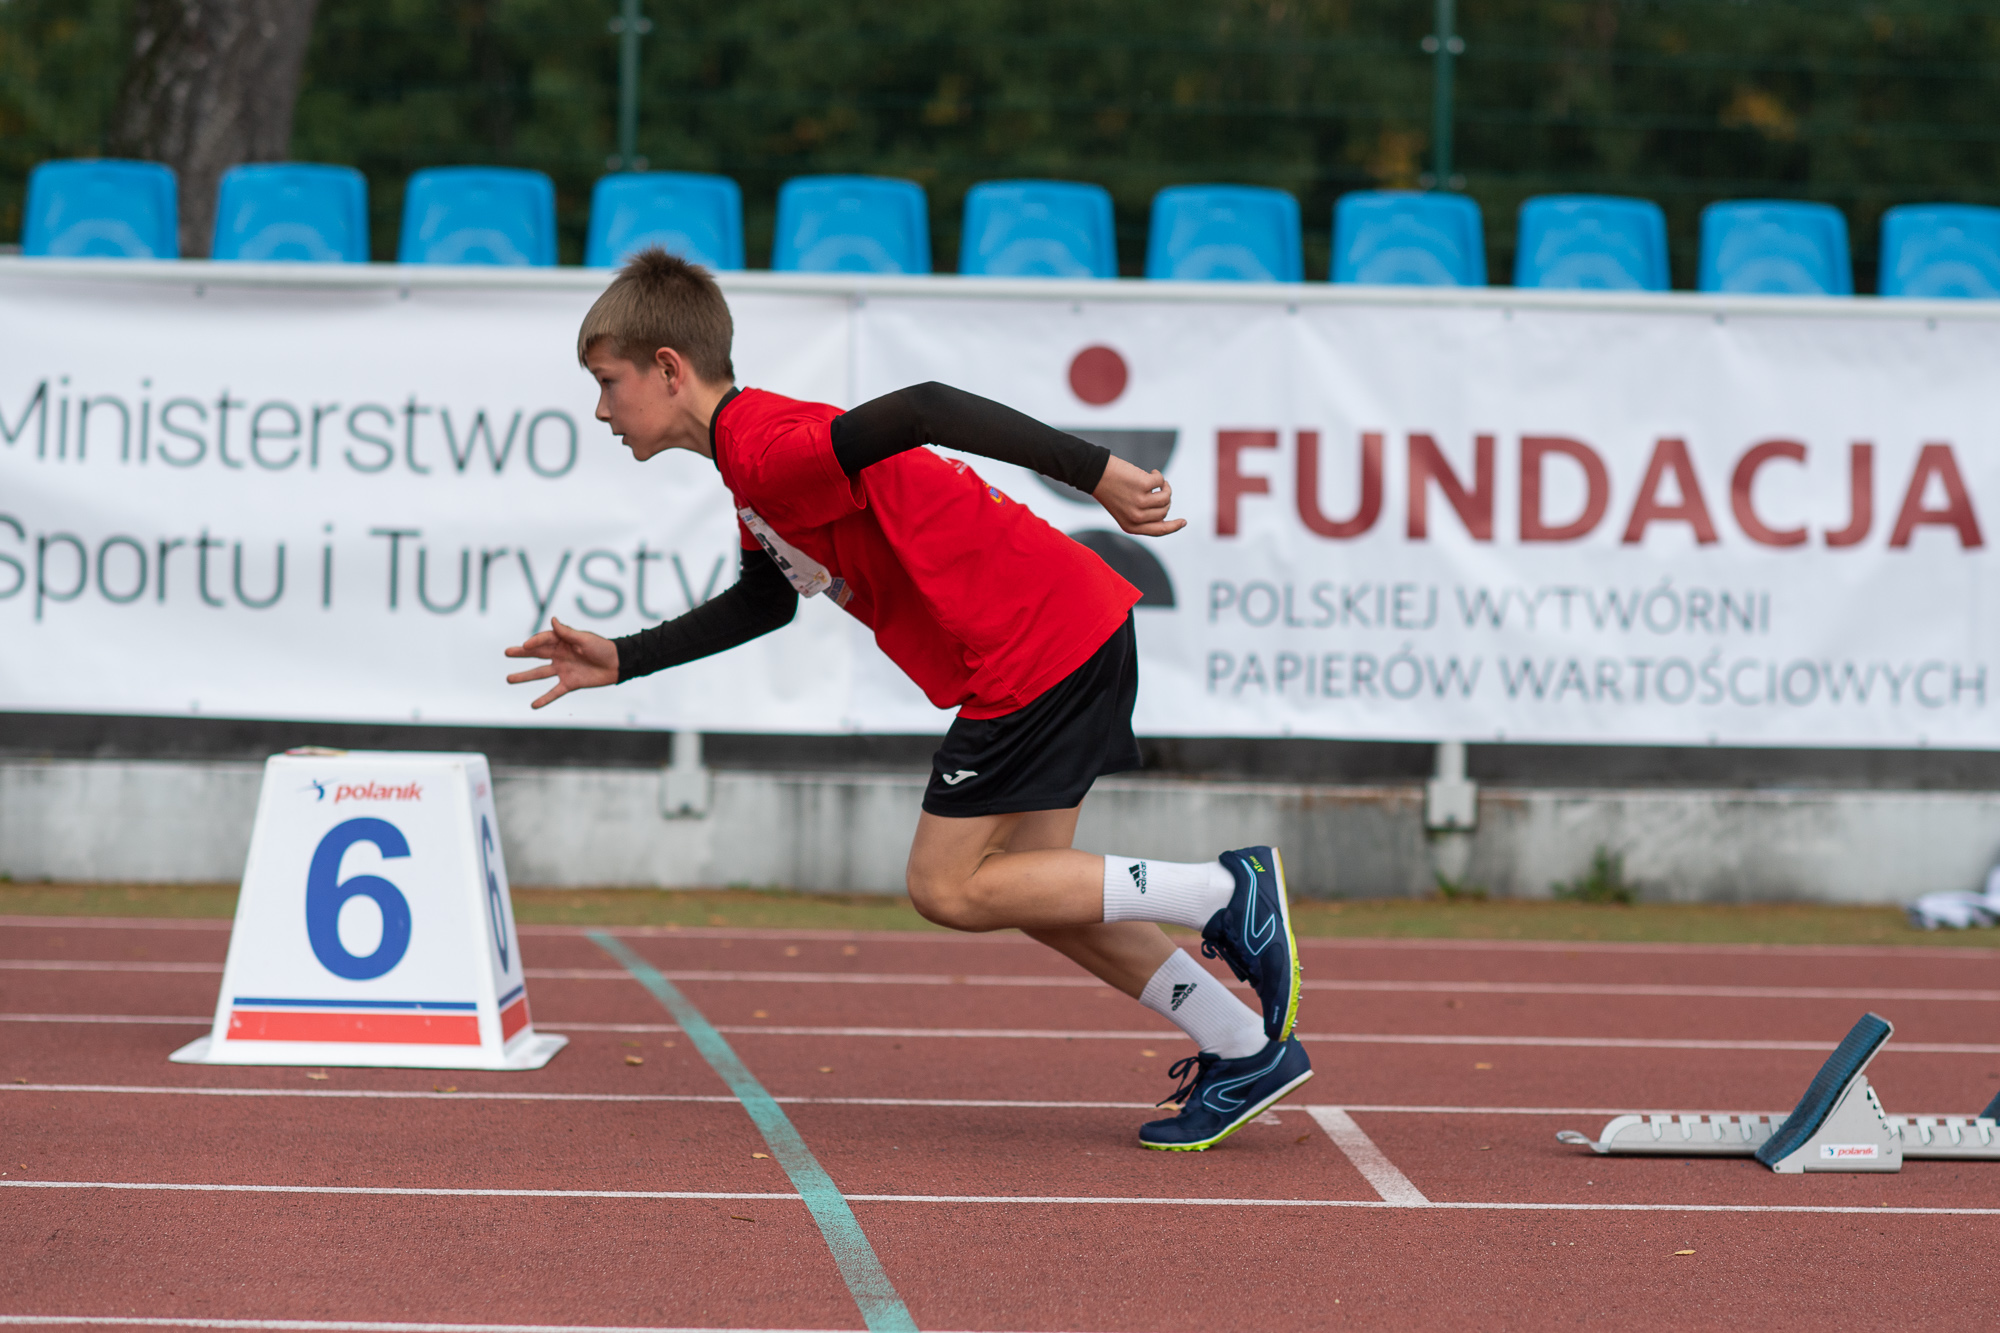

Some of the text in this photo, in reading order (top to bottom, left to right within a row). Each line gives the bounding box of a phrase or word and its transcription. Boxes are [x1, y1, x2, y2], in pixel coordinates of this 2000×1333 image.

[1214, 429, 1985, 551] FUNDACJA
[323, 525, 334, 610] i
[368, 529, 740, 637] Turysty
[1208, 573, 1770, 635] POLSKIEJ WYTWÓRNI
[1207, 640, 1987, 710] PAPIERÓW WARTOŚCIOWYCH
[333, 779, 424, 804] polanik
[306, 816, 411, 981] 6
[481, 813, 509, 975] 6
[1139, 860, 1147, 894] adidas
[1171, 982, 1197, 1011] adidas
